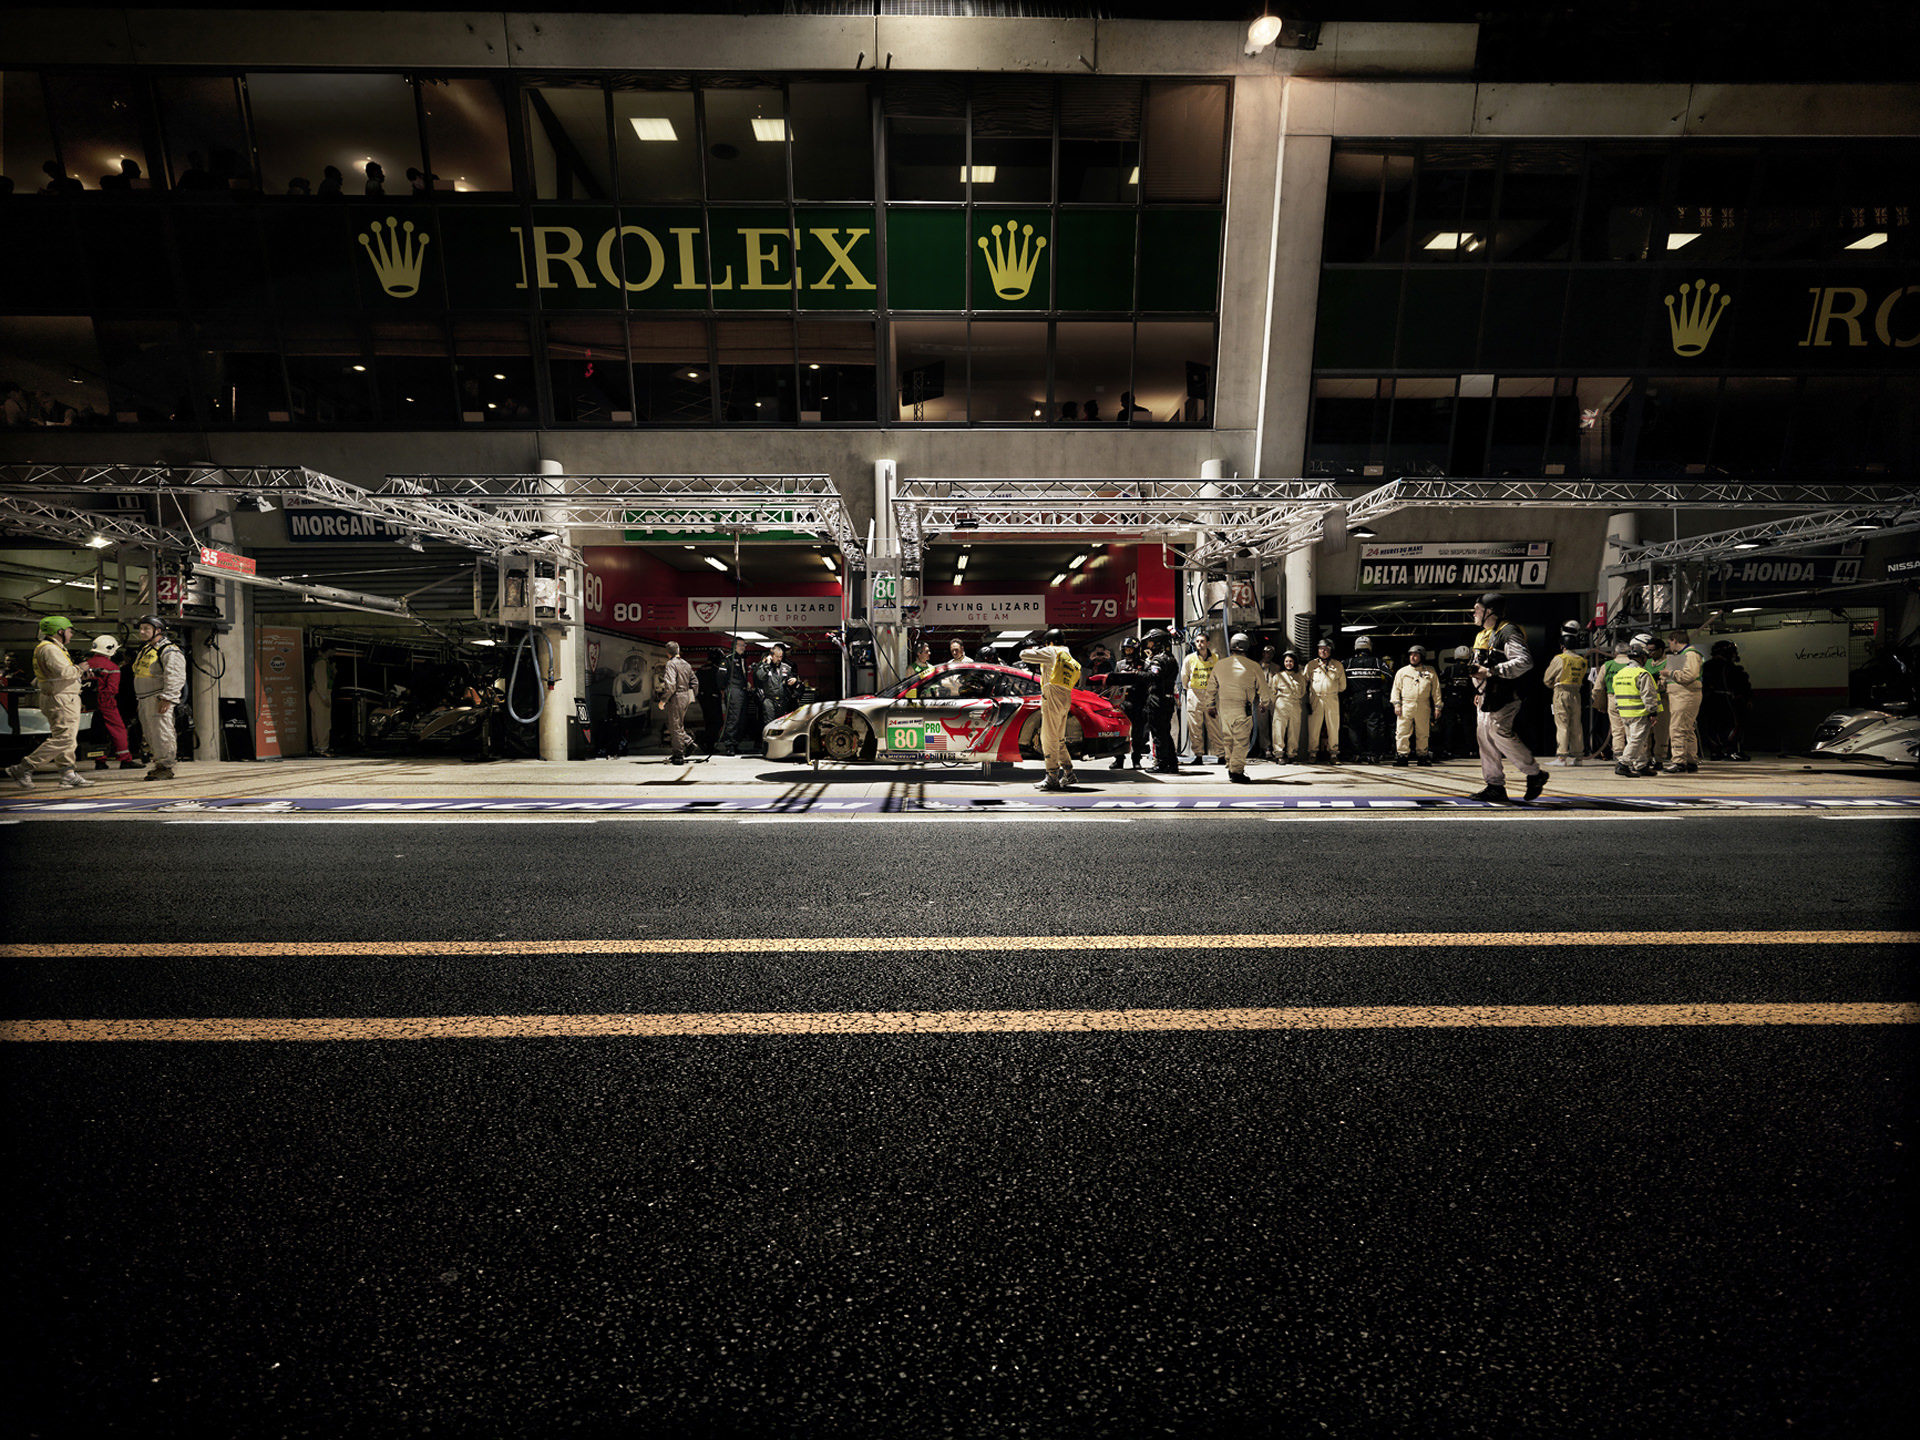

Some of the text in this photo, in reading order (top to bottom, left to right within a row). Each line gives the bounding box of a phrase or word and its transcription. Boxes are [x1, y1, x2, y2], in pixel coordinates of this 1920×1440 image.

[511, 225, 877, 292] ROLEX
[202, 548, 218, 564] 35
[1366, 548, 1379, 557] 24
[1362, 564, 1408, 585] DELTA
[1414, 563, 1458, 585] WING
[1462, 563, 1520, 584] NISSAN
[1887, 560, 1920, 573] NISSA
[585, 571, 603, 614] 80
[875, 579, 897, 599] 80
[1231, 585, 1253, 605] 79
[613, 602, 642, 622] 80
[731, 603, 836, 612] FLYING LIZARD
[937, 601, 1040, 611] FLYING LIZARD
[1090, 598, 1118, 619] 79
[759, 614, 808, 622] GTE PRO
[967, 613, 1009, 621] GTE AM
[925, 722, 941, 733] PRO
[894, 729, 918, 749] 80
[918, 753, 939, 761] Mobil
